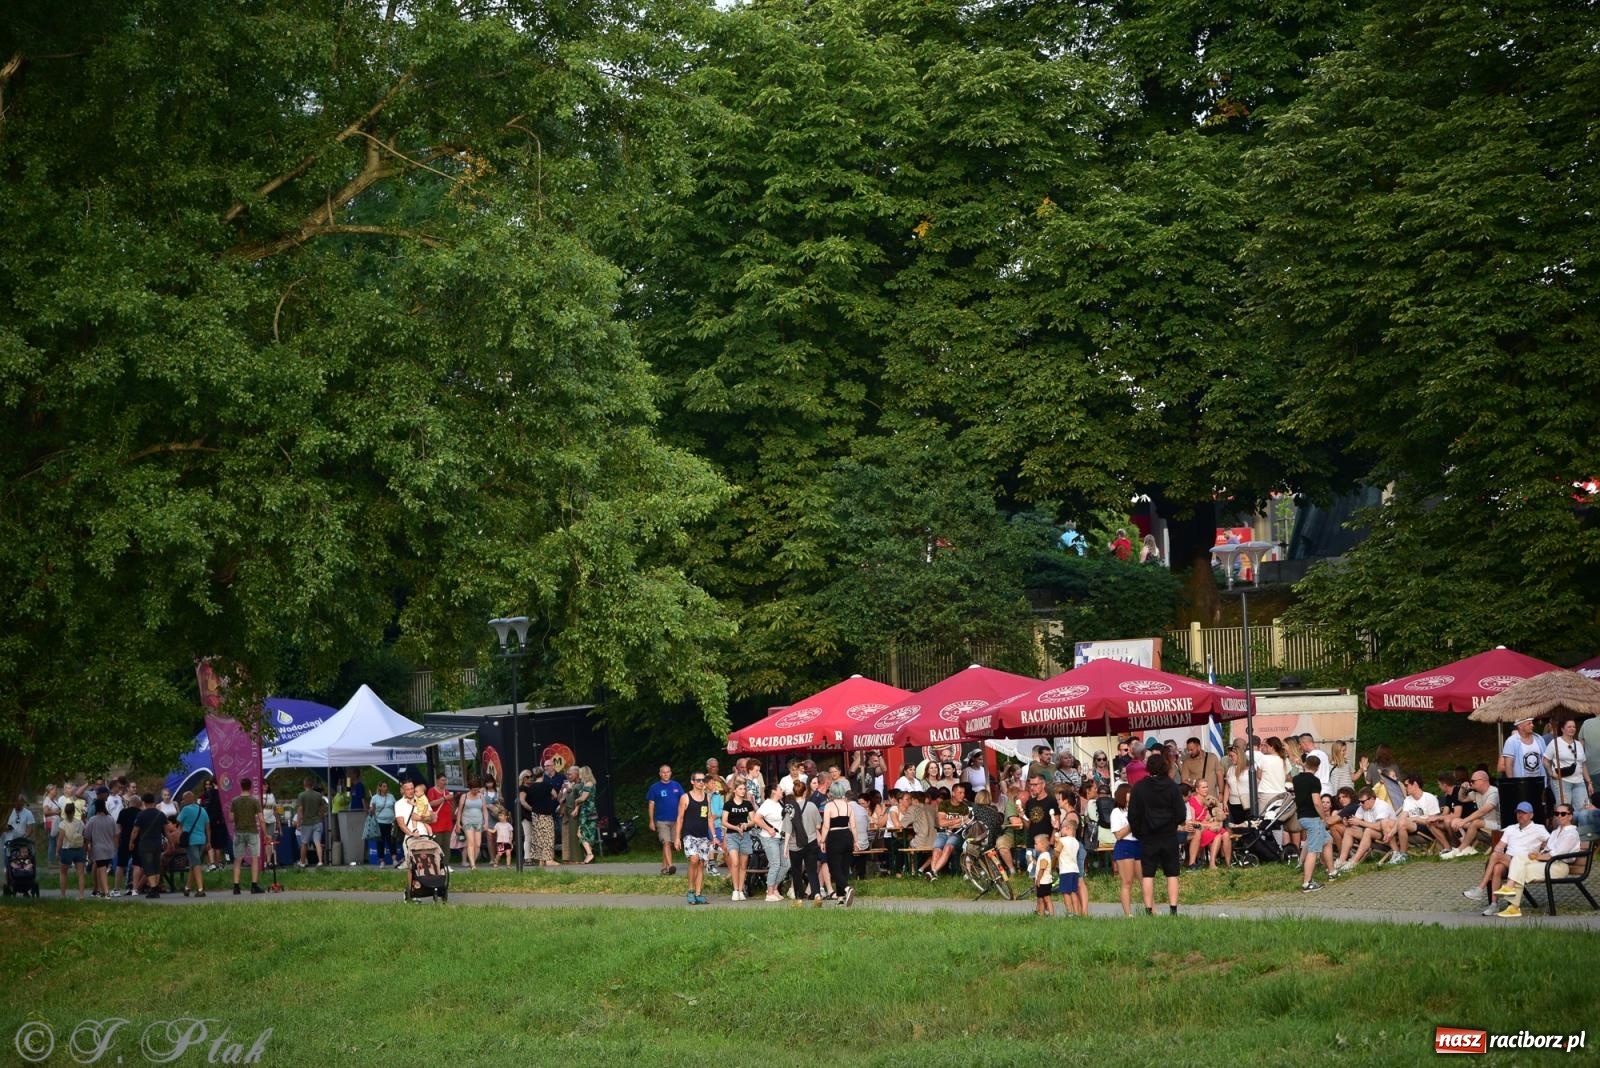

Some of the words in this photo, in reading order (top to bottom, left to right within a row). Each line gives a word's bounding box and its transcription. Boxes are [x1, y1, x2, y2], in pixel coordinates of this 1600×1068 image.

[1128, 697, 1194, 714] RACIBORSKIE
[1384, 693, 1434, 709] RACIBORSKIE
[1021, 704, 1086, 724] RACIBORSKIE
[749, 732, 814, 748] RACIBORSKIE
[853, 732, 895, 748] RACIBORSKIE
[929, 727, 960, 742] RACIB
